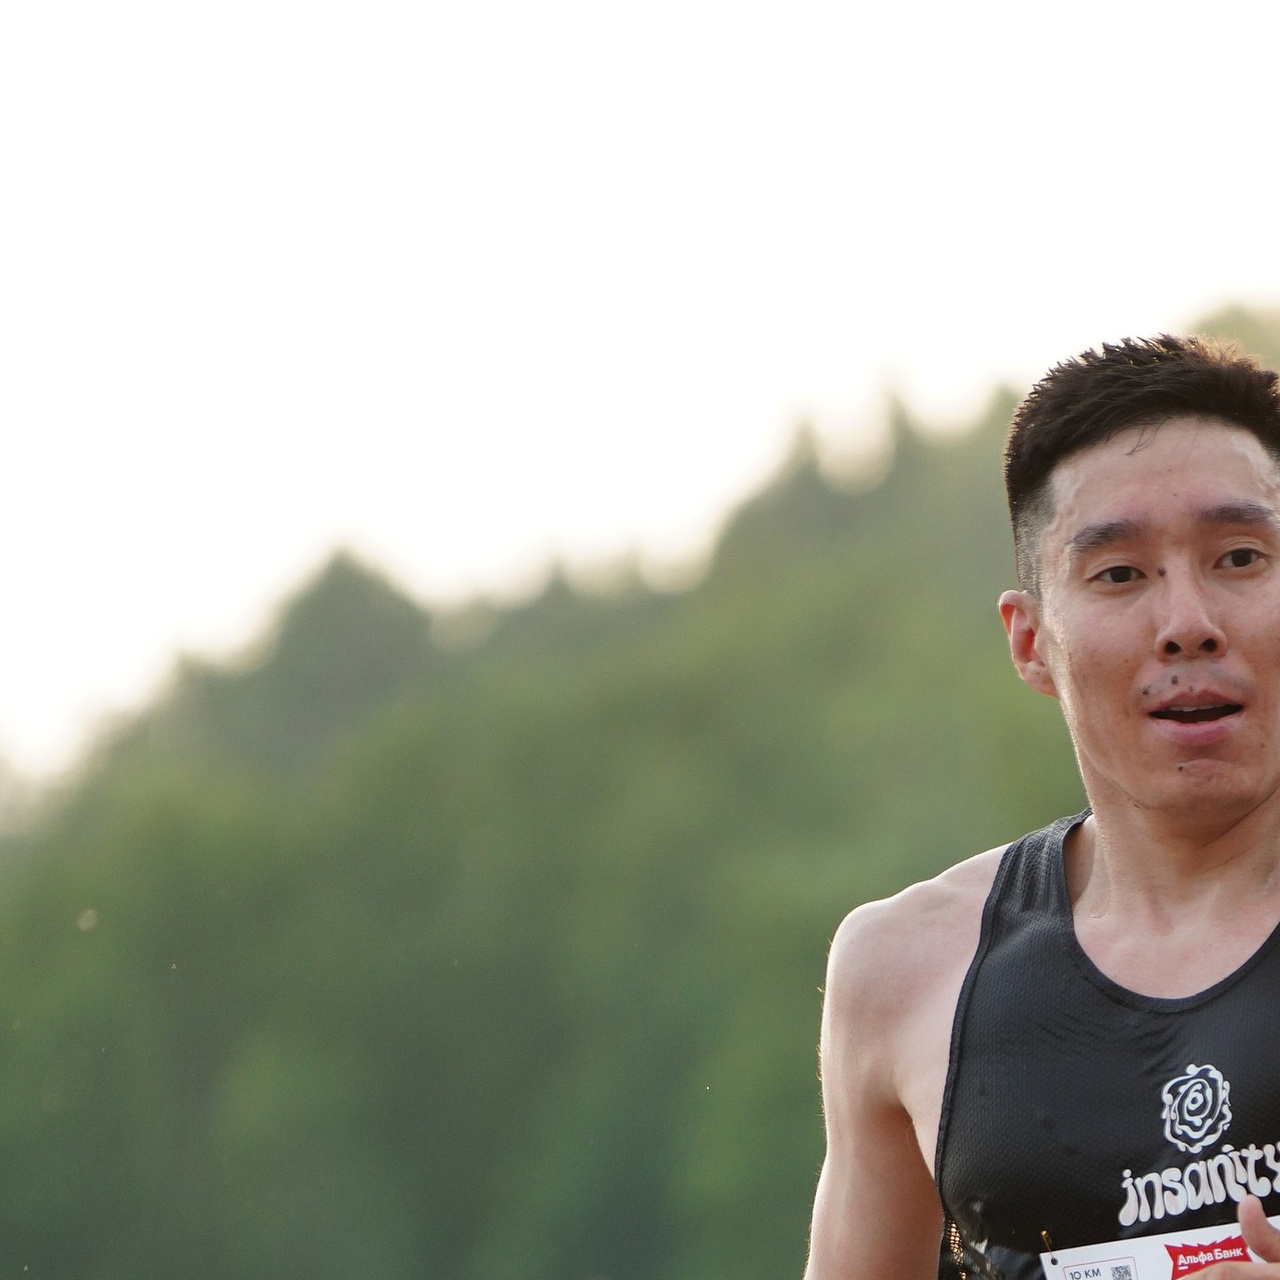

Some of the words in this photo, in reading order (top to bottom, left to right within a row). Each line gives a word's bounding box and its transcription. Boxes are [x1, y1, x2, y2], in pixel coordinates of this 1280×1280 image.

[1177, 1250, 1214, 1270] Альфа
[1214, 1246, 1244, 1261] Банк
[1069, 1270, 1082, 1280] 10
